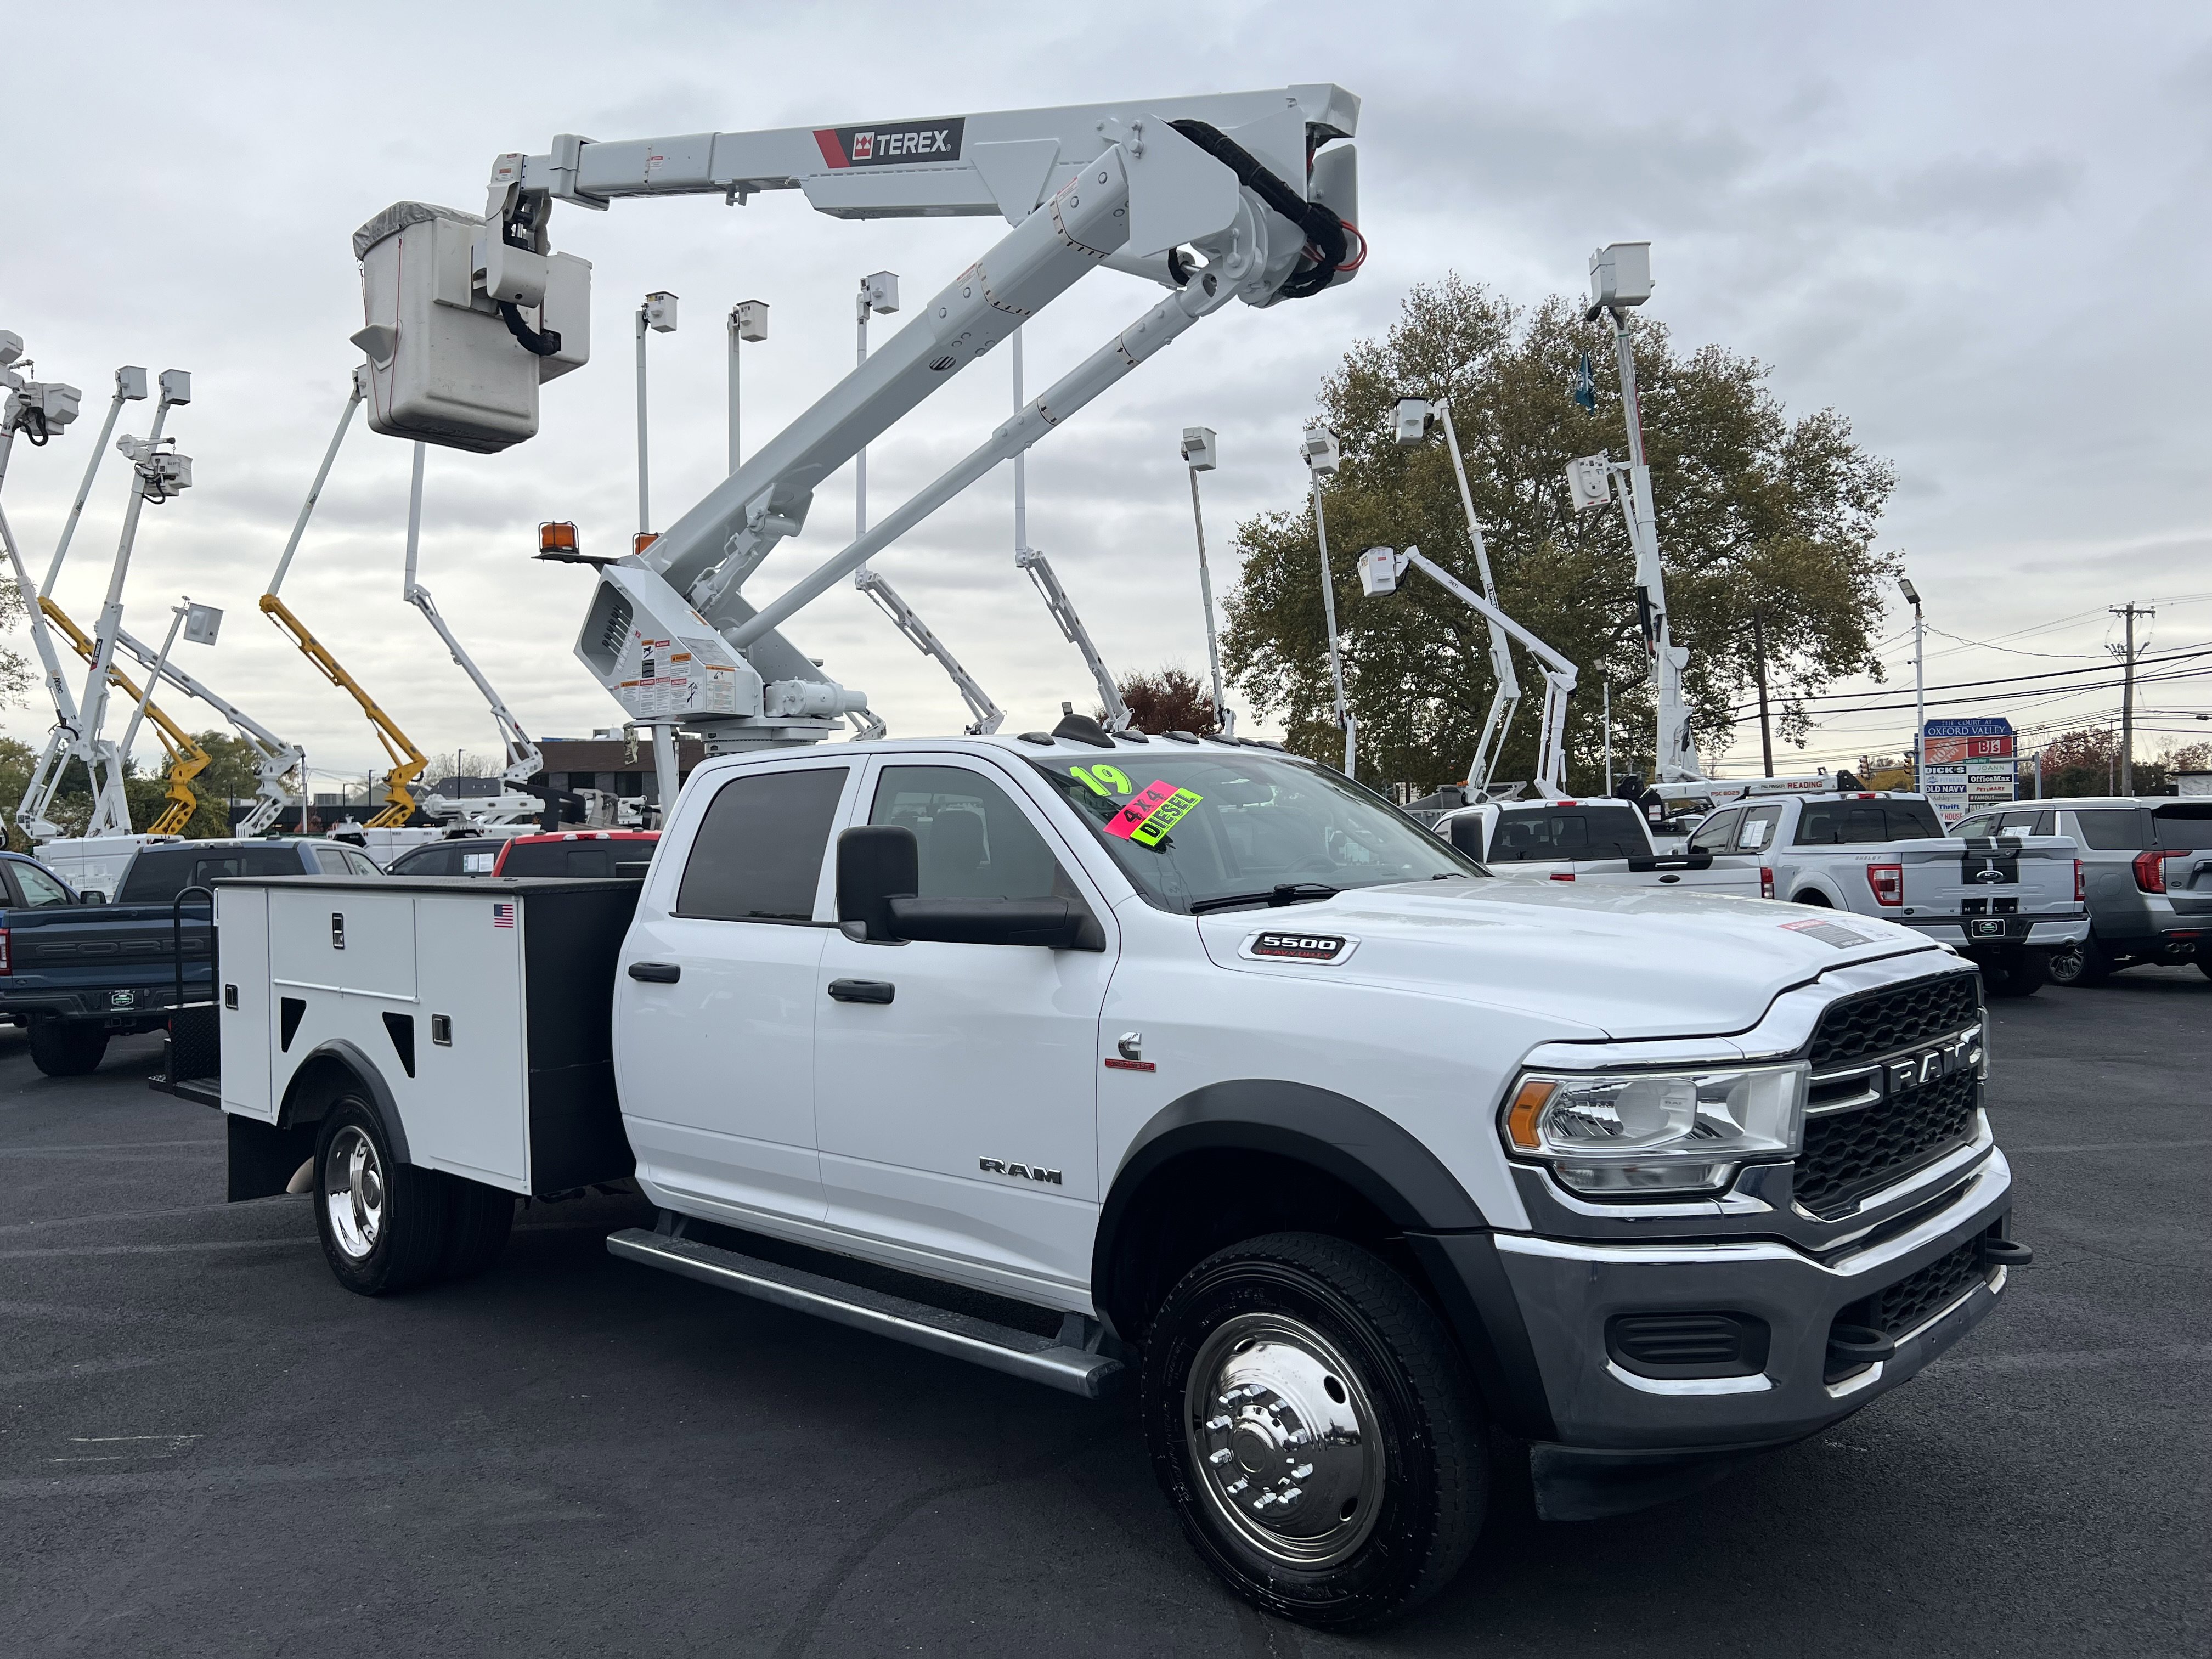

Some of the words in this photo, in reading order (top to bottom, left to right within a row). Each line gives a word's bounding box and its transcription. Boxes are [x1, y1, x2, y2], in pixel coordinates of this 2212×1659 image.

[53, 678, 63, 694] Altec
[877, 678, 949, 704] TEREX
[1928, 727, 1969, 735] OXFORD
[1971, 726, 2006, 734] VALLEY
[1069, 764, 1132, 797] 19
[1139, 793, 1199, 839] DIESEL
[35, 939, 205, 957] FORD
[1263, 936, 1337, 950] 5500
[1889, 1041, 1971, 1093] RAM
[979, 1155, 1063, 1186] RAM
